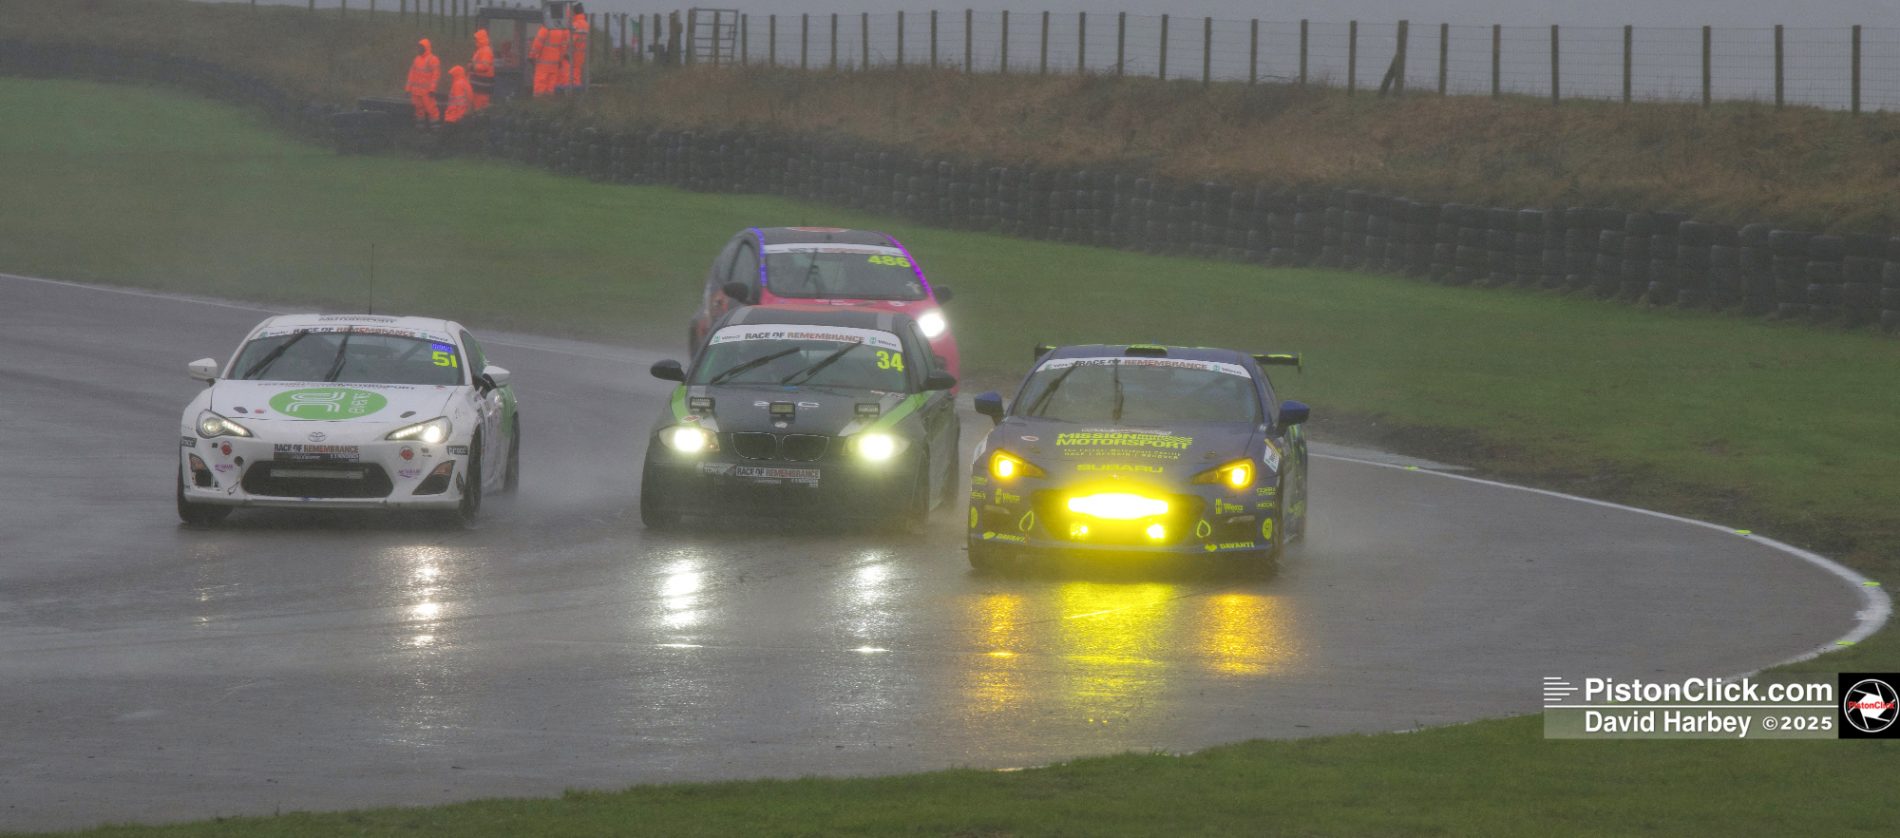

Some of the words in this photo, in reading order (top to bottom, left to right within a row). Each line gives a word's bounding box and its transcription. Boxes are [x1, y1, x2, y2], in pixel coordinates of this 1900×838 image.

[868, 255, 911, 268] 486
[787, 332, 865, 343] REMEMBRANCE
[432, 350, 458, 368] 51
[876, 351, 904, 372] 34
[1075, 360, 1105, 368] RACE
[1124, 360, 1208, 370] REMEMBRANCE
[1059, 432, 1137, 440] MISSION
[274, 443, 292, 452] RACE
[304, 444, 359, 453] REMEMBRANCE
[1056, 438, 1190, 449] MOTORSPORT
[737, 466, 754, 477] RACE
[1077, 464, 1163, 473] SUBARU
